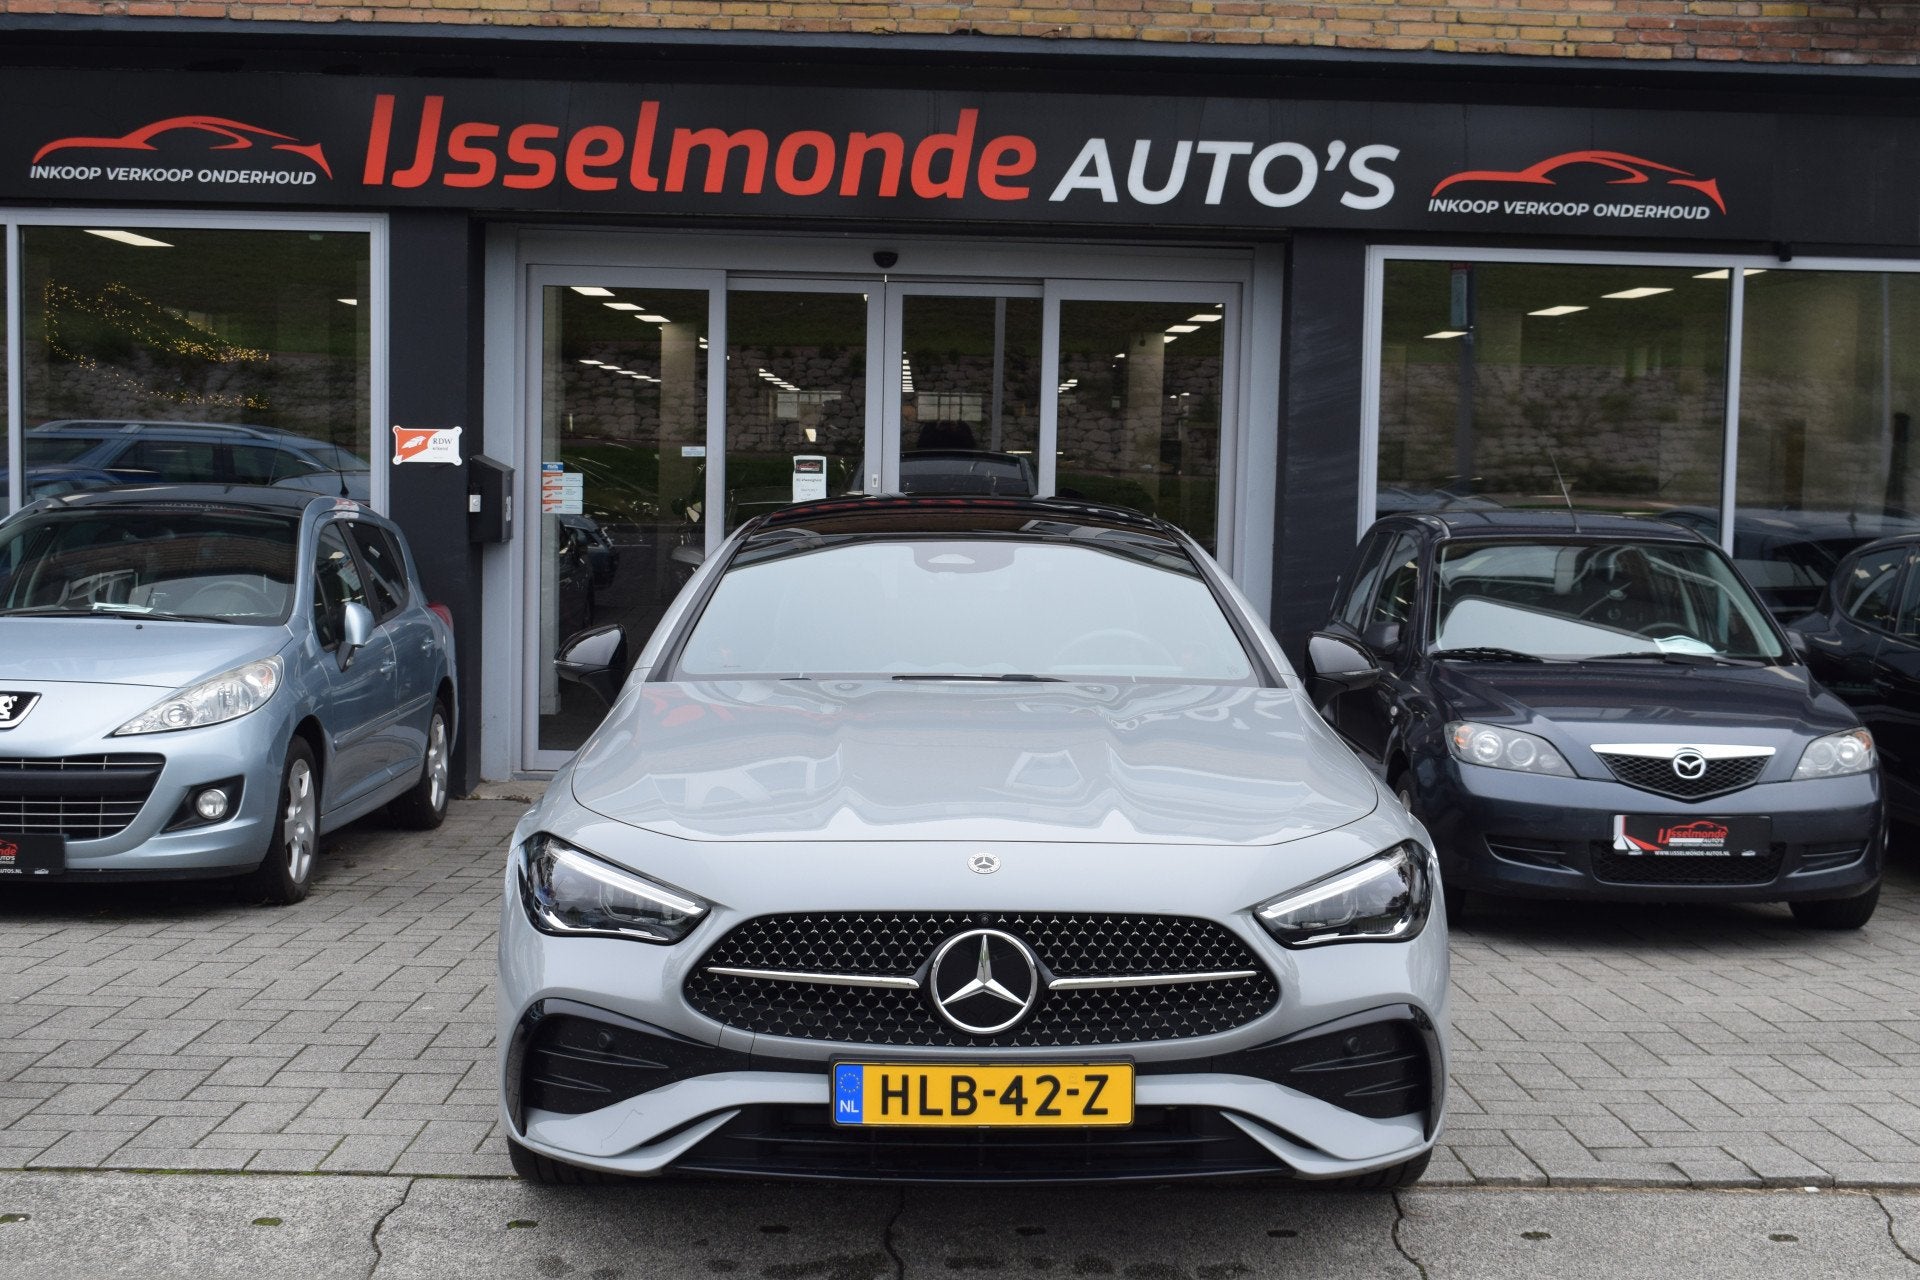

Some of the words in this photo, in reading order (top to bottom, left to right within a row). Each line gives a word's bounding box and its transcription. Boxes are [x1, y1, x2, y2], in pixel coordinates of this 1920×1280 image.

[362, 94, 1037, 200] IJsselmonde
[1048, 137, 1400, 211] AUTO'S
[30, 165, 102, 180] INKOOP
[106, 166, 194, 183] VERKOOP
[197, 168, 317, 186] ONDERHOUD
[1428, 198, 1499, 214] INKOOP
[1503, 200, 1590, 217] VERKOOP
[1593, 202, 1711, 221] ONDERHOUD
[839, 1100, 859, 1113] NL
[881, 1074, 1109, 1116] HLB-42-Z
